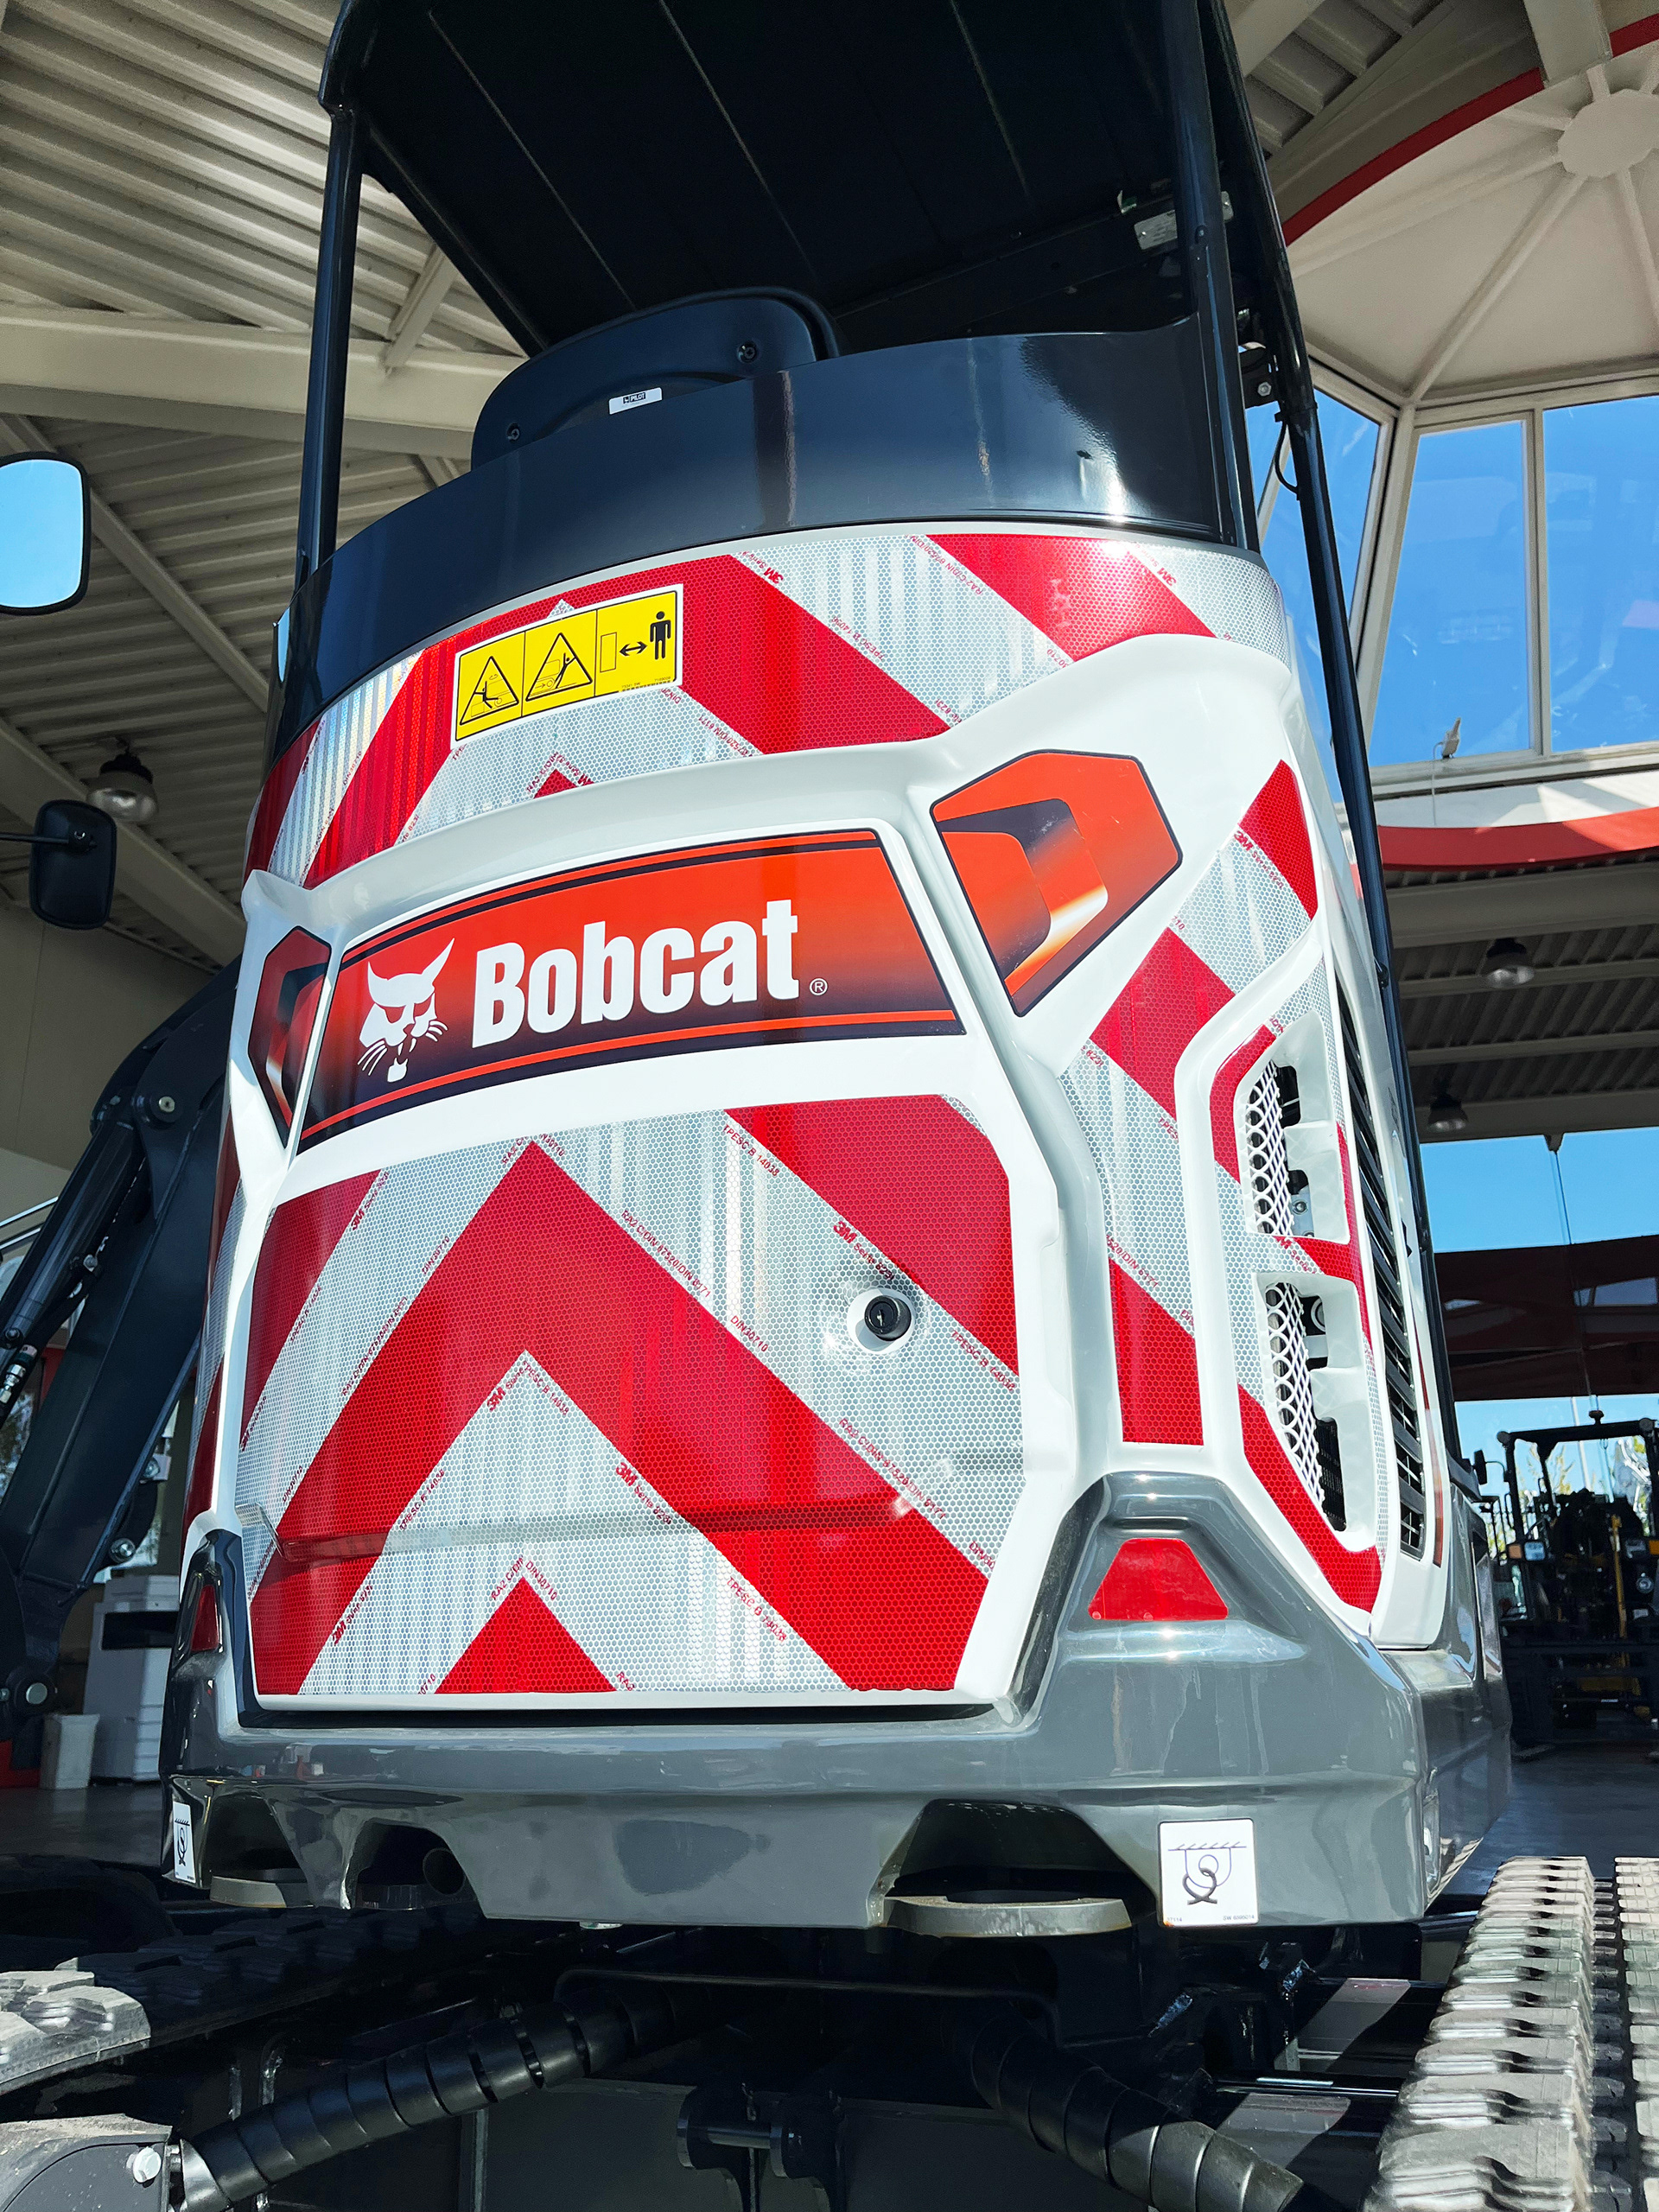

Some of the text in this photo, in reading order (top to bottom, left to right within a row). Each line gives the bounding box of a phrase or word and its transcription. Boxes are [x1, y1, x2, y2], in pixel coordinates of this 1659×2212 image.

[764, 567, 784, 584] 3M
[1157, 568, 1176, 586] 3M
[1234, 830, 1254, 851] 3M
[472, 899, 800, 1049] Bobcat
[722, 1123, 750, 1150] TPESC
[748, 1147, 757, 1156] B
[351, 1208, 365, 1230] 3M
[621, 1210, 639, 1227] RA2
[833, 1221, 858, 1243] 3M
[730, 1315, 769, 1352] DIN30710
[486, 1386, 506, 1412] 3M
[615, 1462, 639, 1486] 3M
[525, 1560, 558, 1600] DIN30710
